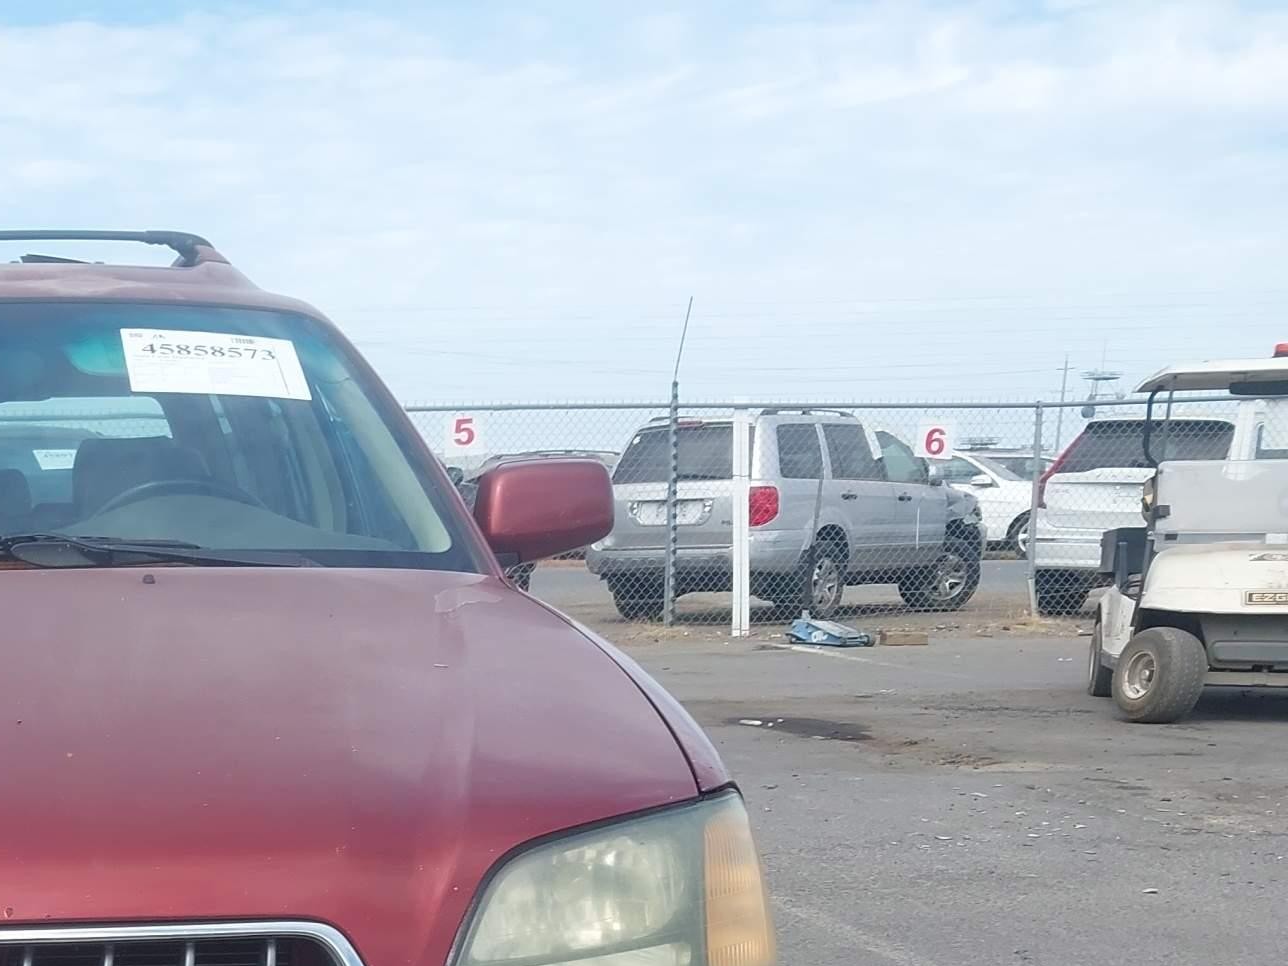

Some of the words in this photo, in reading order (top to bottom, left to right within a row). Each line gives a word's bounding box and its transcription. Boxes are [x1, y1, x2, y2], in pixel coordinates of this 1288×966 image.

[142, 342, 275, 361] 45858573
[454, 418, 475, 446] 5
[925, 428, 946, 455] 6
